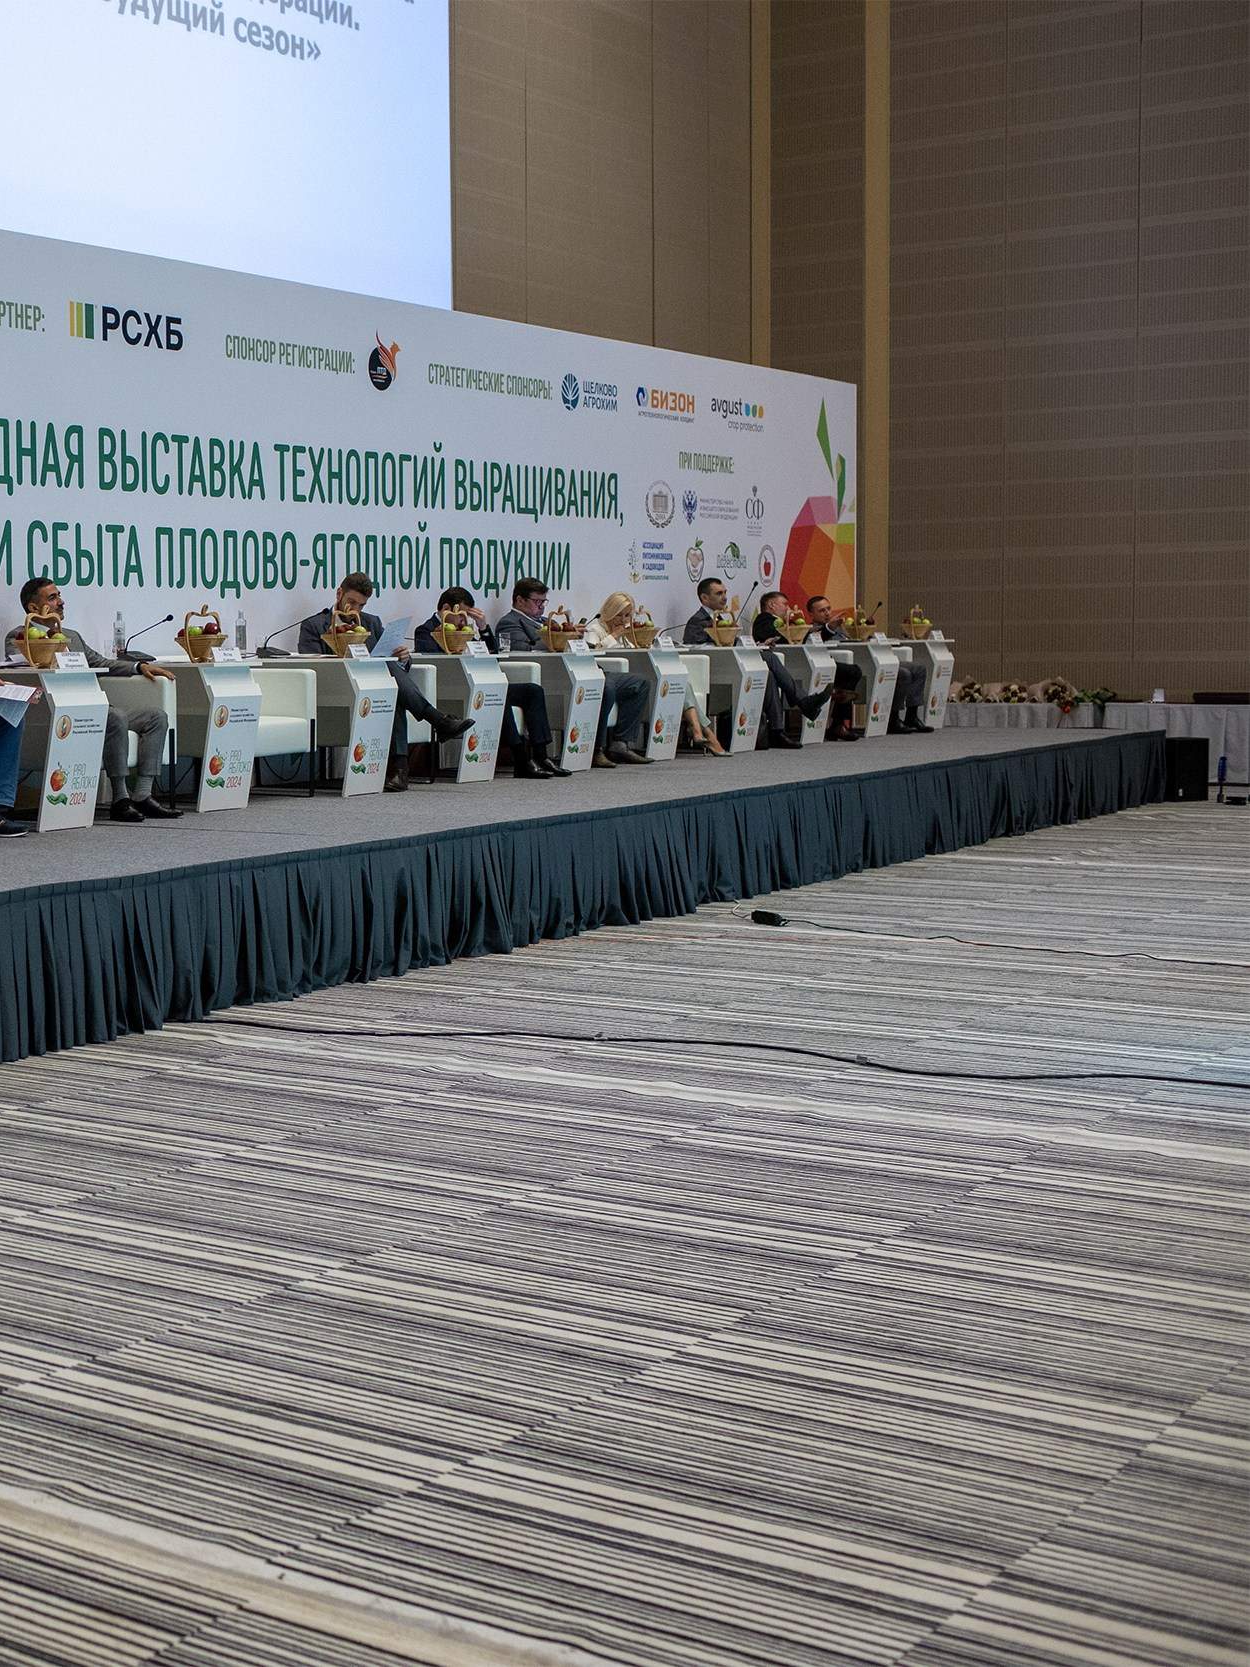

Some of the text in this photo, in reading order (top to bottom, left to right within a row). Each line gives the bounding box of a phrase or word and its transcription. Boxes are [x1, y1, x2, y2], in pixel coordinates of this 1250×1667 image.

[233, 16, 321, 61] сезон»
[101, 304, 184, 351] РСХБ
[225, 334, 356, 375] СПОНСОР РЕГИСТРАЦИИ:
[428, 362, 553, 401] СТРАТЕГИЧЕСКИЕ СПОНСОРЫ:
[582, 380, 618, 397] ЩЕЛКОВО
[582, 396, 618, 412] АГРОХИМ
[651, 389, 695, 414] БИЗОН
[711, 397, 743, 419] avgust
[728, 420, 740, 431] crop
[679, 451, 735, 474] ПРИ ПОДДЕРЖКЕ:
[98, 427, 266, 501] ВЫСТАВКА
[273, 441, 446, 510] ТЕХНОЛОГИЙ
[454, 458, 624, 527] ВЫРАЩИВАНИЯ,
[745, 498, 765, 520] СФ
[26, 519, 144, 588] СБЫТА
[155, 521, 431, 600] ПЛОДОВО-ЯГОДНОЙ
[439, 537, 571, 600] ПРОДУКЦИИ
[226, 776, 242, 789] 2024
[69, 792, 87, 806] 2024
